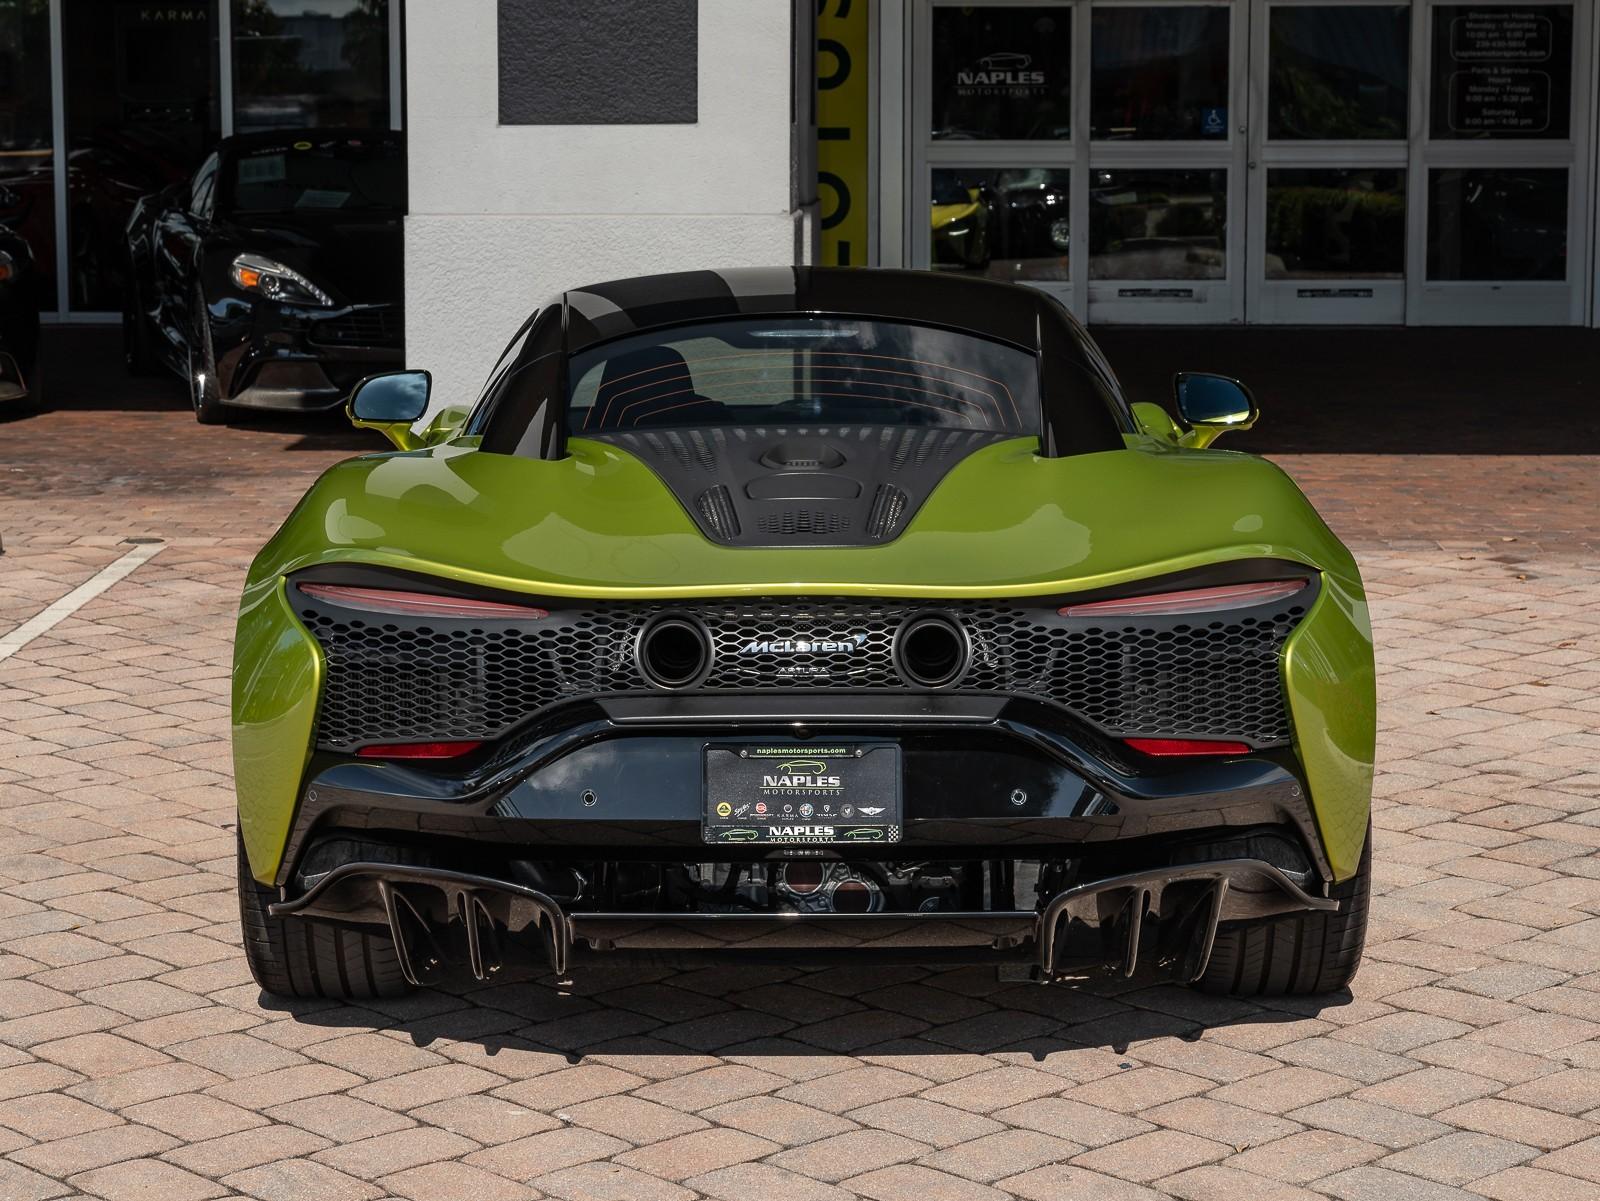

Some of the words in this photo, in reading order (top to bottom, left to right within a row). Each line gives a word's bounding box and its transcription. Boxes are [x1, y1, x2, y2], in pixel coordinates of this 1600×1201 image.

[140, 9, 207, 21] KARMA
[1465, 21, 1496, 30] Monday
[1503, 21, 1537, 30] Saturday
[1471, 66, 1491, 74] Parts
[1493, 66, 1499, 74] &
[1501, 66, 1529, 74] Service
[957, 71, 1045, 85] NAPLES
[1488, 76, 1512, 84] Hours
[957, 87, 1045, 96] MOTORSPORTS
[1469, 85, 1499, 94] Monday
[1506, 85, 1531, 94] Friday
[1482, 108, 1516, 117] Saturday
[739, 641, 855, 653] McLaren
[763, 775, 841, 787] NAPLES
[769, 826, 835, 836] NAPLES
